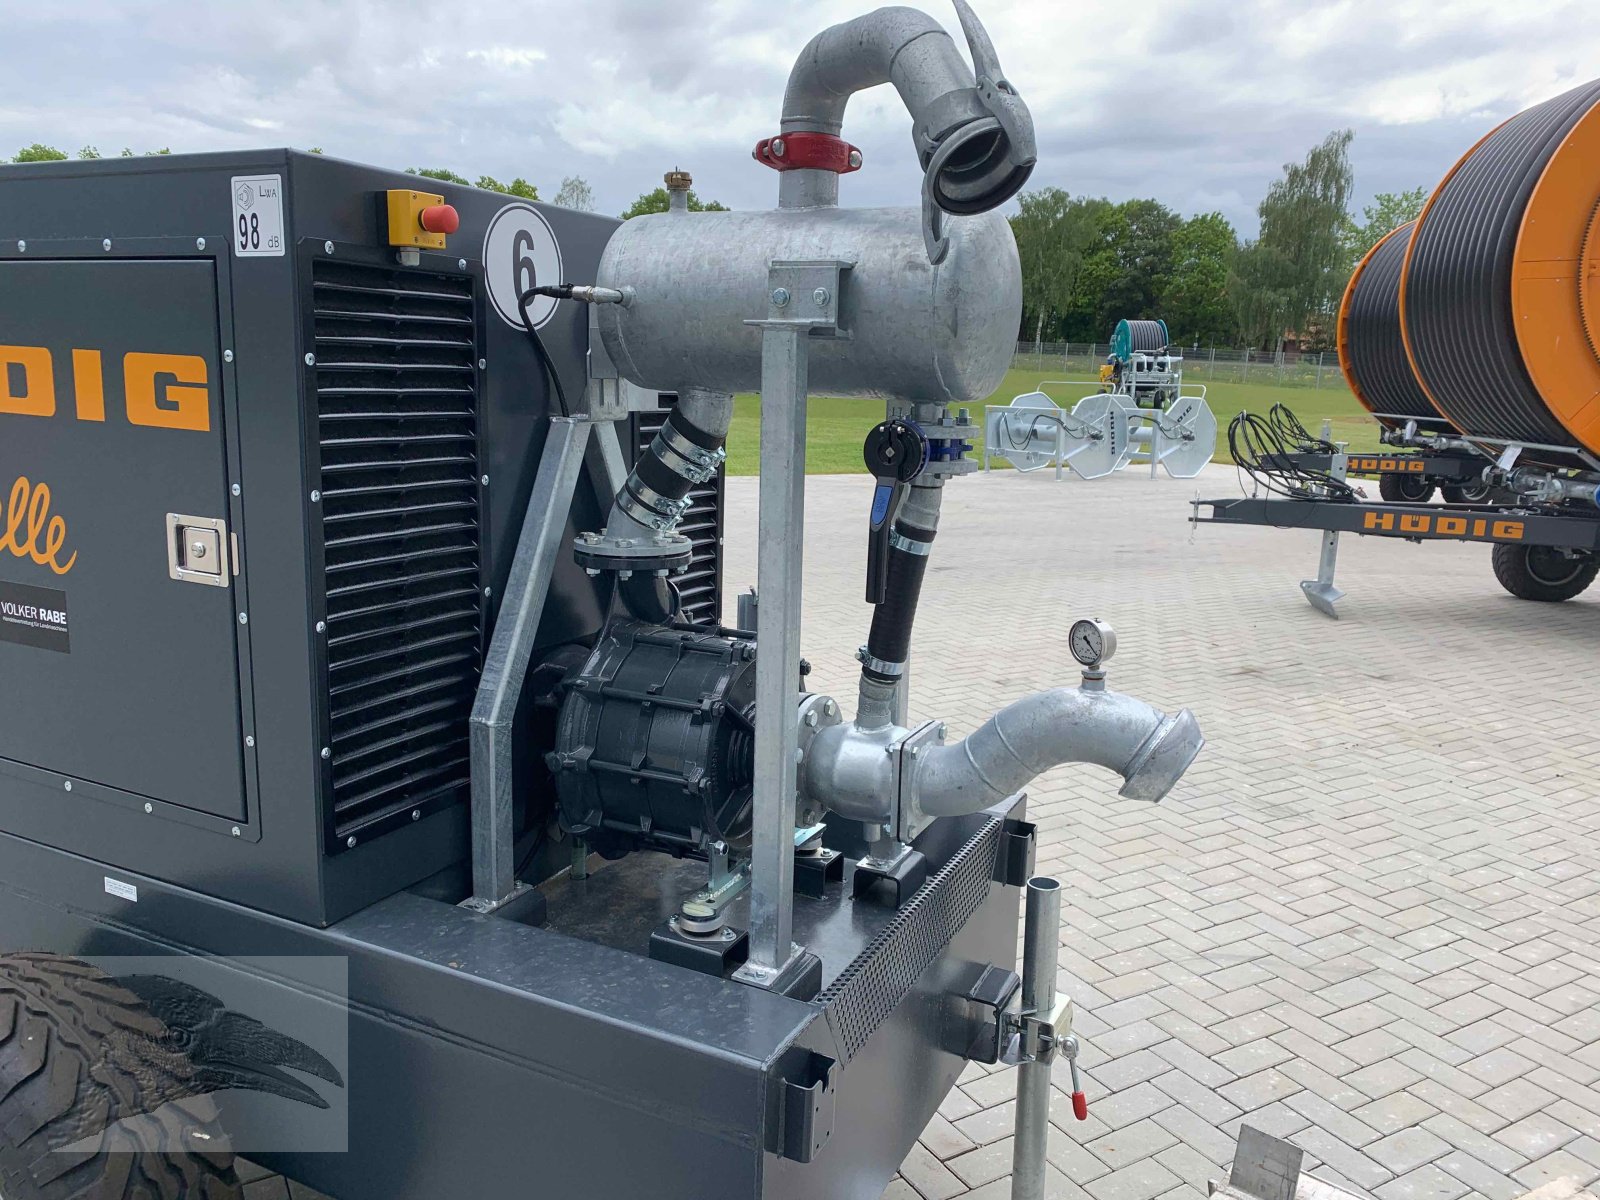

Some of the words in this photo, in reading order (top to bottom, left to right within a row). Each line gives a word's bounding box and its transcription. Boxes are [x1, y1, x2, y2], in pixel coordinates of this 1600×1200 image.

[239, 212, 260, 250] 98
[267, 235, 280, 248] dB
[512, 229, 537, 307] 6
[0, 345, 210, 432] DIG
[0, 476, 77, 575] lle
[1363, 511, 1525, 540] HÜDIG
[1, 601, 38, 619] VOLKER
[39, 608, 67, 625] RABE
